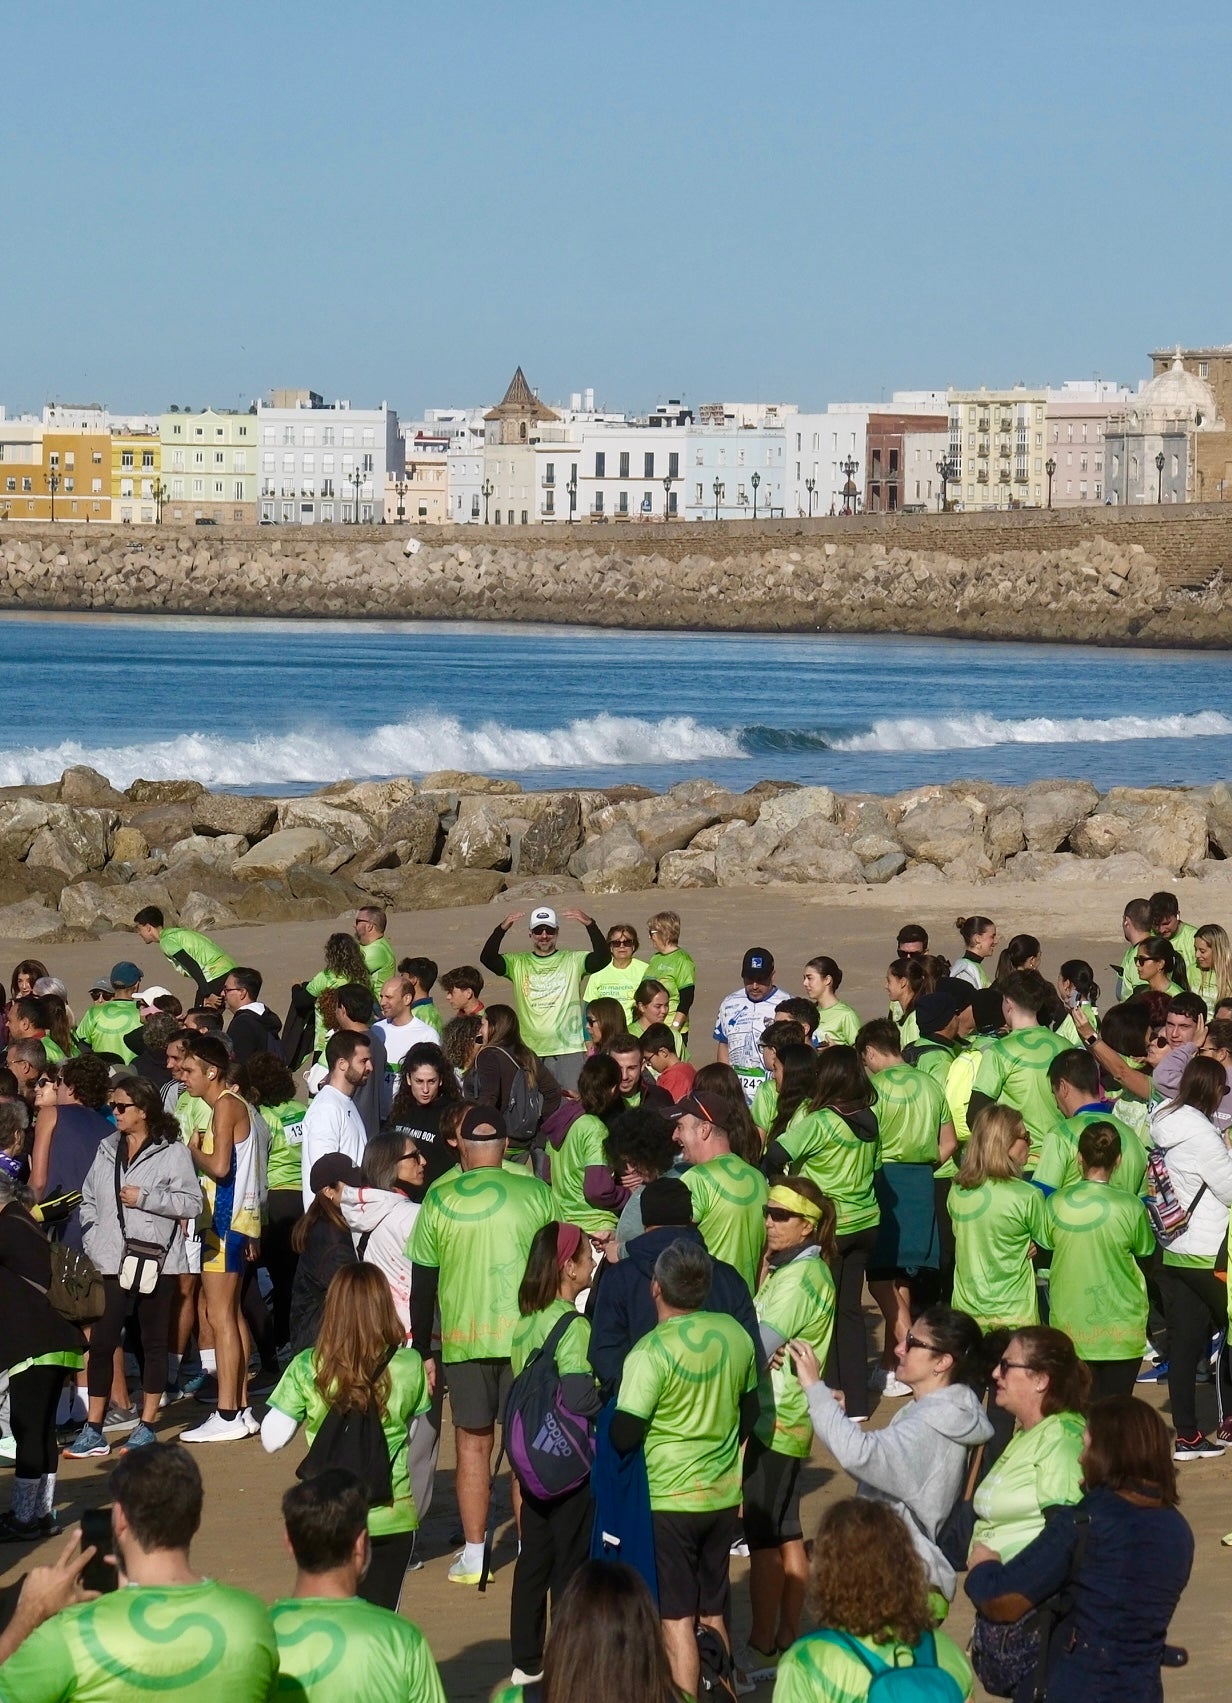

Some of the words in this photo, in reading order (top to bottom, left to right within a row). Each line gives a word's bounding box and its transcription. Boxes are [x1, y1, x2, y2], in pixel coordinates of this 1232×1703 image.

[291, 1124, 303, 1137] 13
[421, 1131, 436, 1143] BOX
[544, 1411, 572, 1457] adidas
